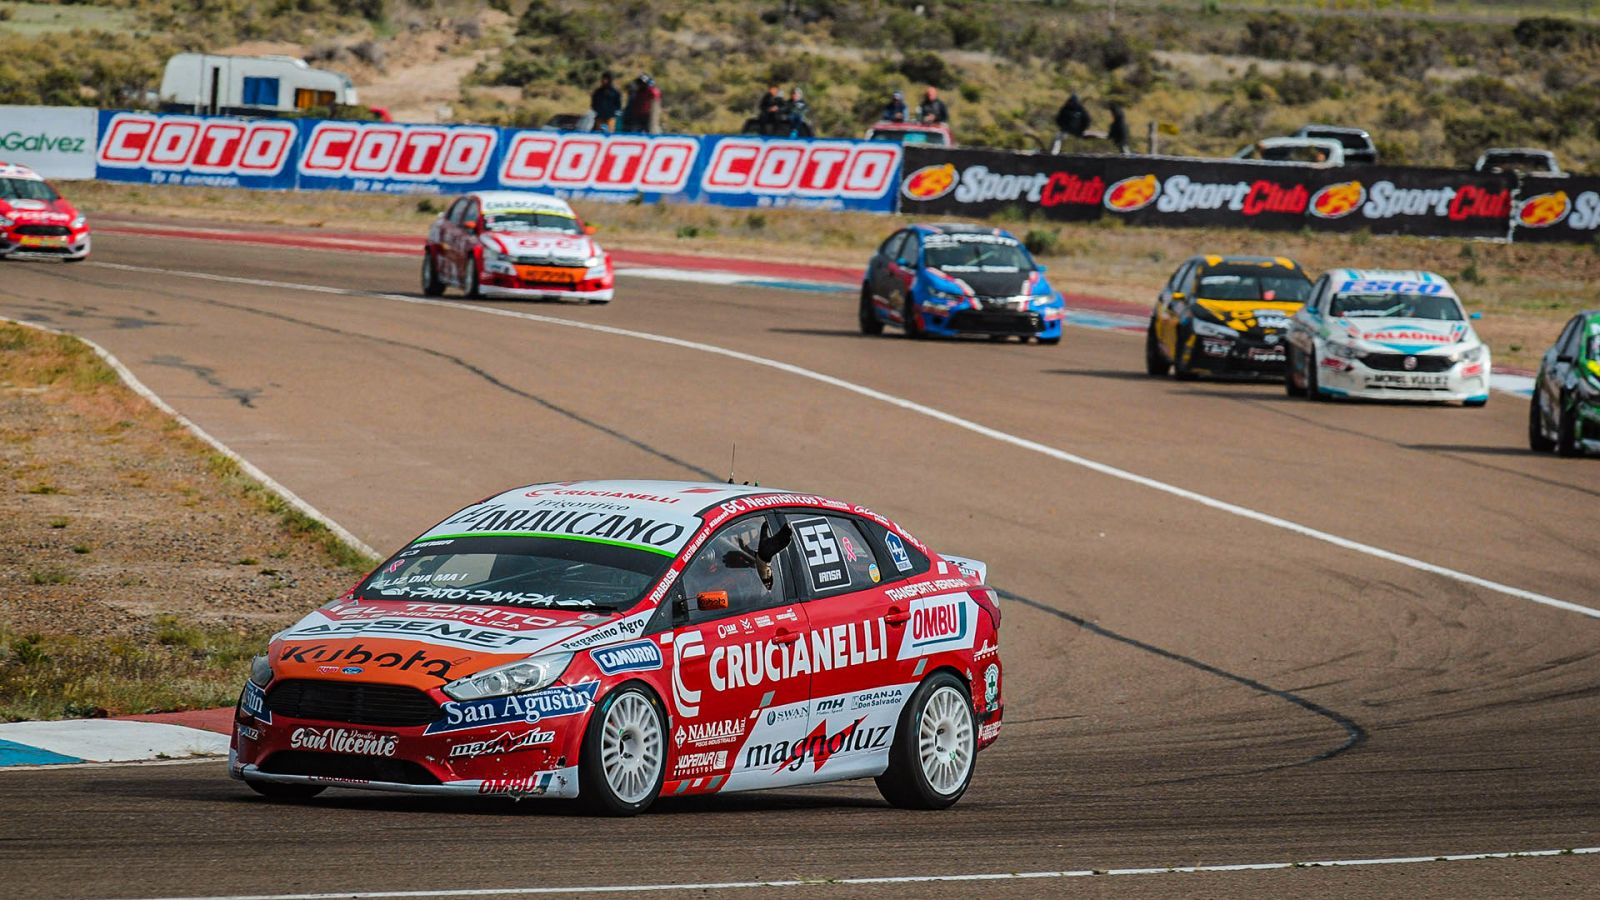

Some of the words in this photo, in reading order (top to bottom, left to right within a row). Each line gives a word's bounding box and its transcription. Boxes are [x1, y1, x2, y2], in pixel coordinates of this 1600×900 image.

[100, 116, 294, 173] COTO
[301, 124, 494, 179] COTO
[502, 134, 696, 189] COTO
[705, 140, 898, 195] COTO
[954, 165, 1105, 207] SportClub
[1157, 174, 1310, 216] SportClub
[1362, 180, 1511, 221] SportClub
[553, 488, 681, 504] CRUCIANELLI
[466, 509, 685, 546] ARAUCANO
[798, 524, 840, 567] 55
[409, 587, 471, 599] PATO
[466, 590, 556, 606] PAMPA
[649, 568, 680, 605] TRABASIL
[405, 603, 557, 627] TORITO
[912, 603, 957, 640] OMBU
[561, 628, 618, 650] Pergamino
[618, 619, 645, 634] Agro
[279, 643, 452, 682] Kubota
[598, 645, 659, 668] CAMURRI
[708, 617, 889, 692] CRUCIANELLI
[446, 701, 497, 725] San
[777, 706, 810, 720] SWAN
[858, 689, 903, 702] GRANJA
[858, 701, 871, 709] Don
[871, 697, 903, 707] Salvador
[452, 730, 555, 756] magnoluz
[687, 718, 741, 741] NAMARA
[744, 719, 892, 772] magnoluz
[673, 765, 713, 776] REPUESTOS
